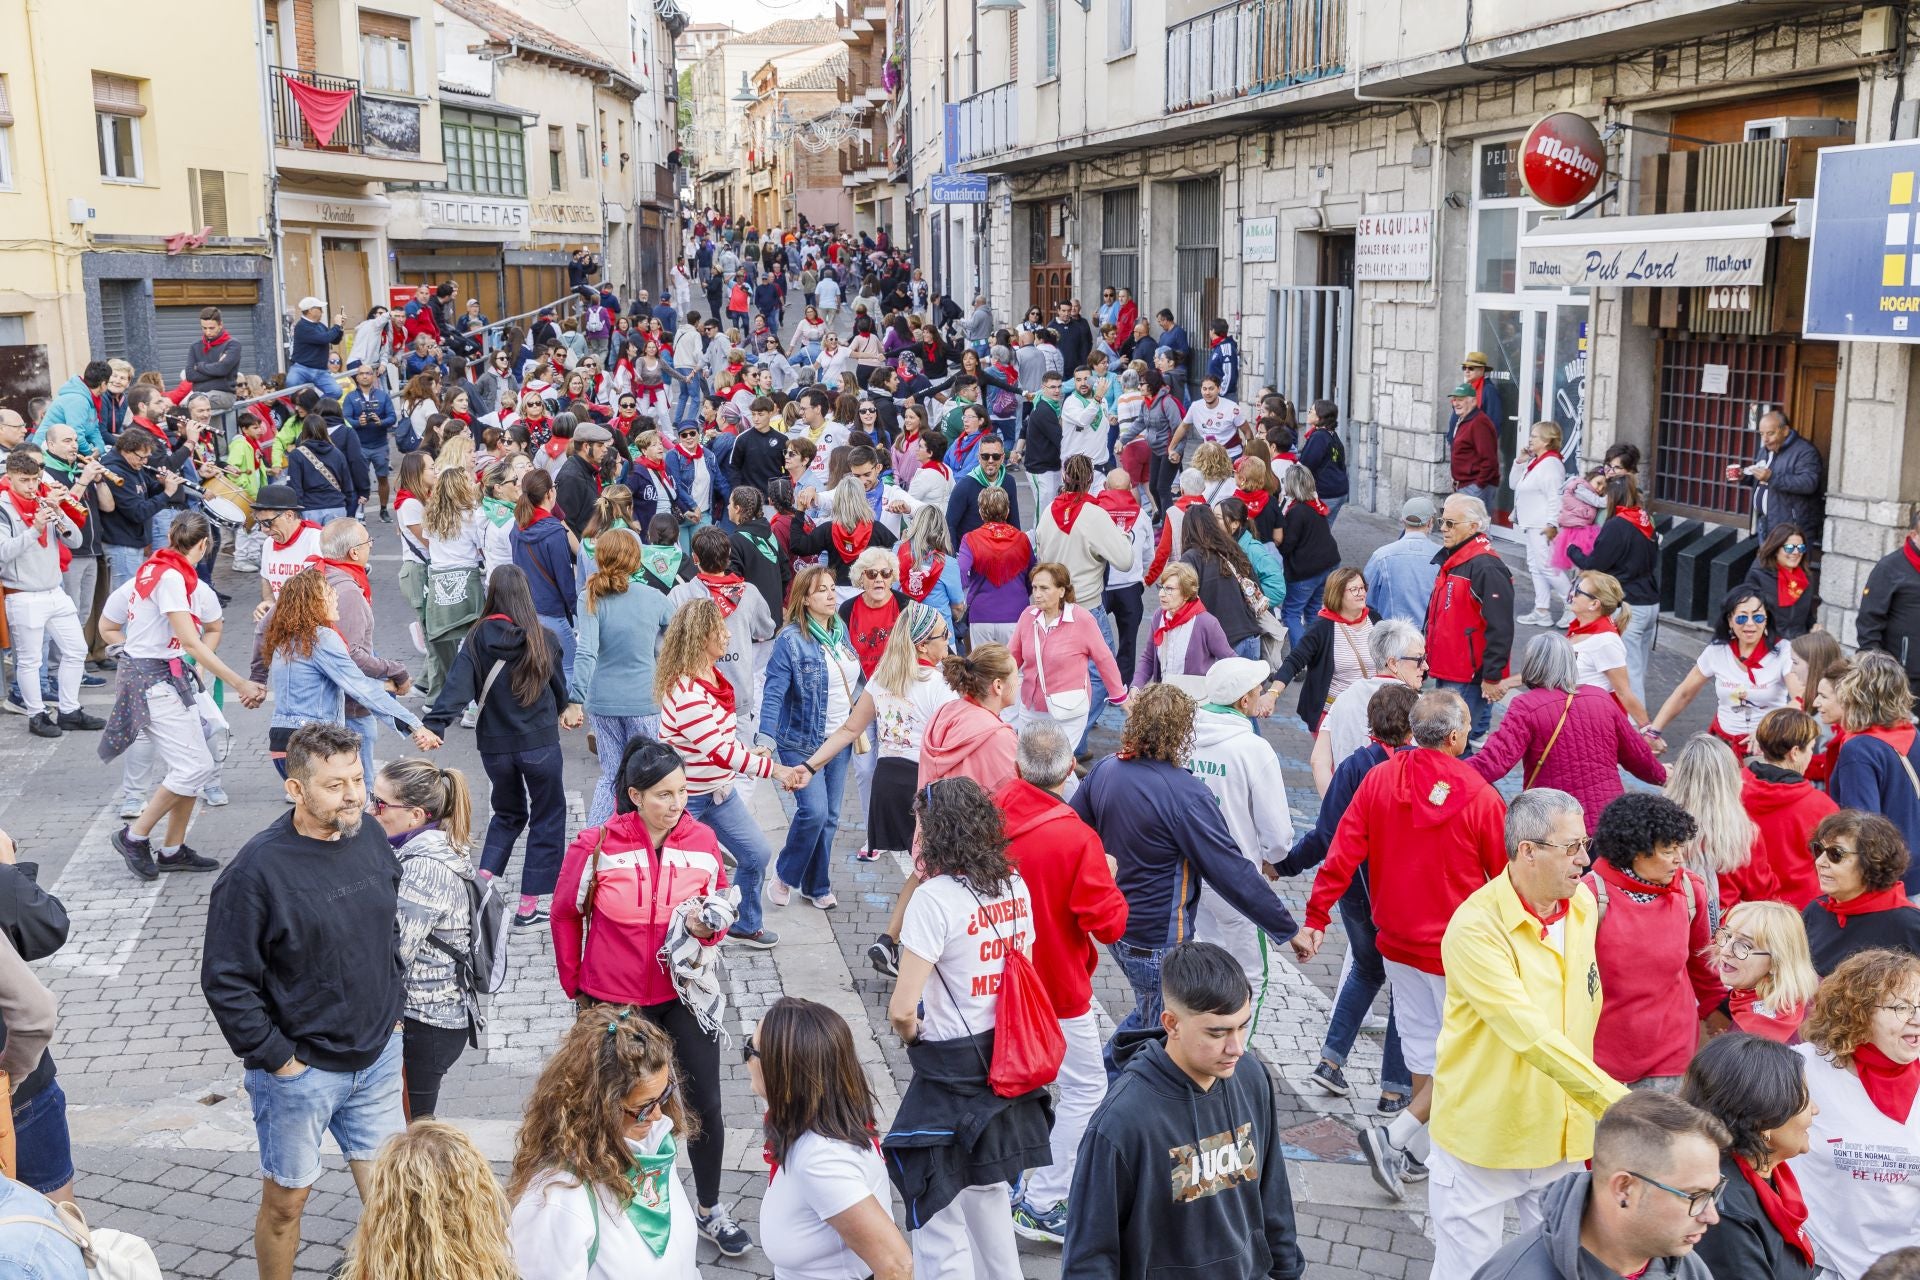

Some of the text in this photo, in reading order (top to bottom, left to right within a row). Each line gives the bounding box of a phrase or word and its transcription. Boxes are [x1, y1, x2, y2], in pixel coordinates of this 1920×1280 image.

[1537, 135, 1599, 178] Mahou
[933, 187, 986, 201] Cantábrico
[430, 202, 521, 226] BICICLETAS
[1358, 216, 1429, 236] SE ALQUILAN
[1529, 249, 1752, 281] Mahou Pub Lord Mahou
[1708, 285, 1750, 309] Lord
[1880, 296, 1920, 312] HOGAR
[268, 563, 276, 575] LA
[1854, 1150, 1863, 1159] BE
[1881, 1160, 1897, 1169] JUST
